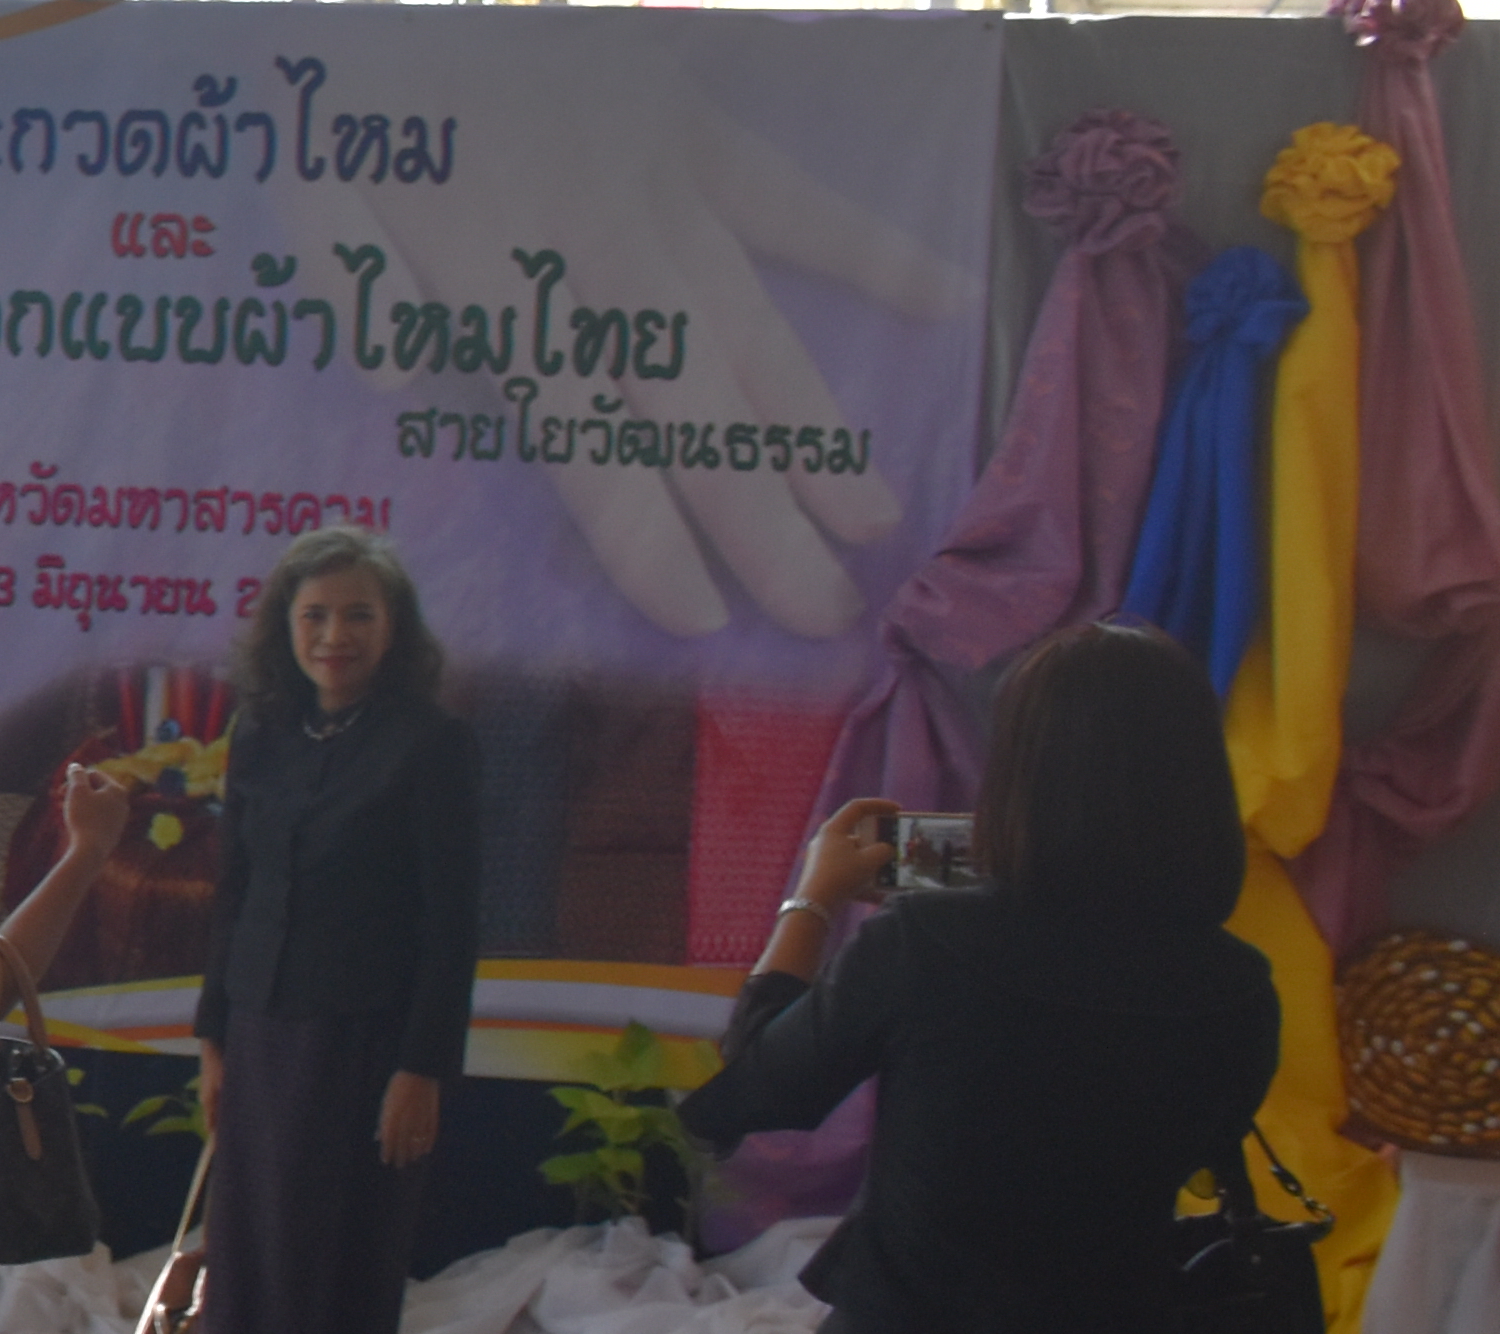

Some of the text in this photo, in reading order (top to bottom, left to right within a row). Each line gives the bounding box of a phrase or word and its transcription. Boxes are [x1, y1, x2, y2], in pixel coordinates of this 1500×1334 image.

[111, 212, 217, 259] และ
[396, 376, 871, 475] สายใยวัฒนธรรม
[32, 553, 218, 631] มิถุนายน
